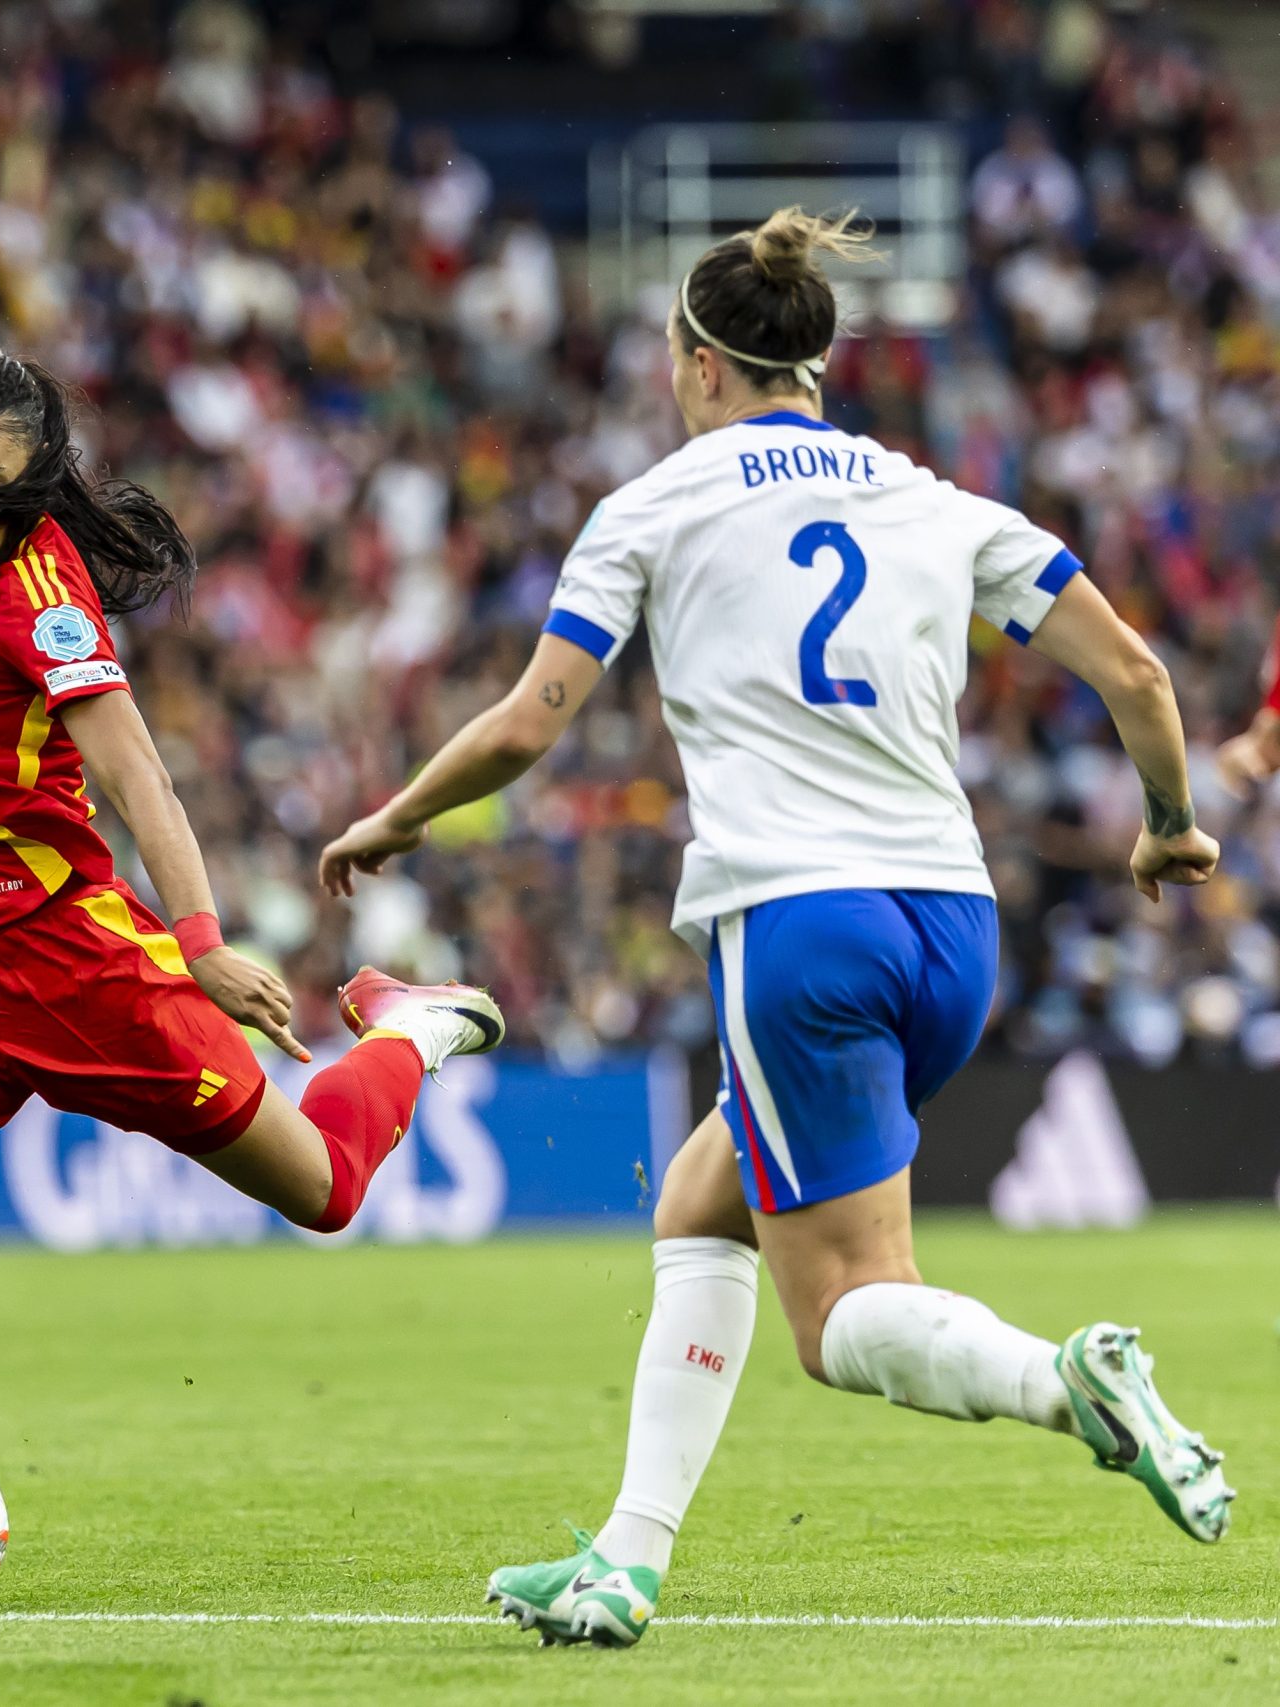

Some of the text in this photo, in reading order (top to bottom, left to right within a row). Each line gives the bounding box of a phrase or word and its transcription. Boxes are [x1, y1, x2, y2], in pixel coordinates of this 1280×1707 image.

[738, 444, 884, 489] BRONZE
[788, 520, 877, 708] 2
[686, 1343, 726, 1374] ENG
